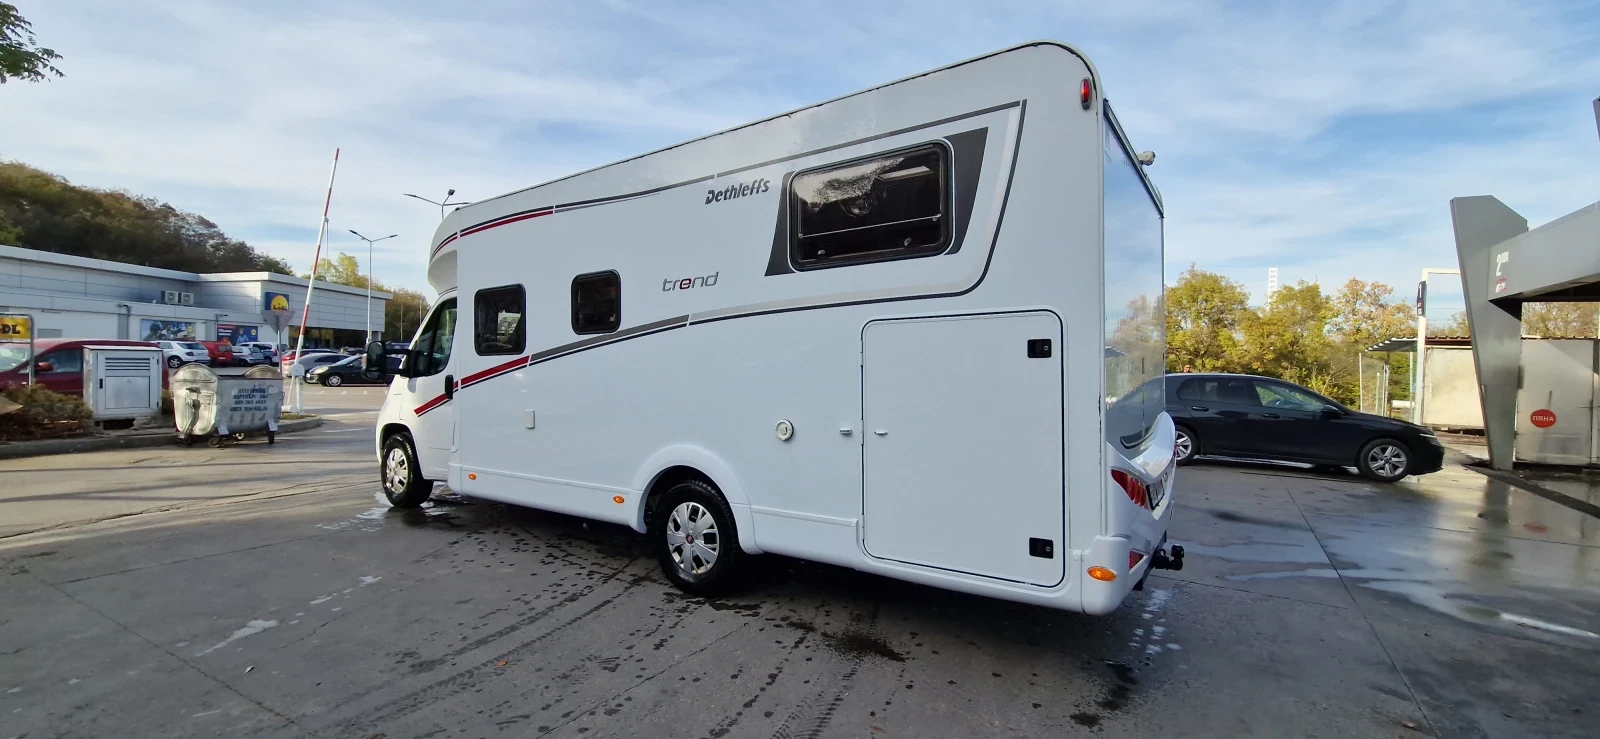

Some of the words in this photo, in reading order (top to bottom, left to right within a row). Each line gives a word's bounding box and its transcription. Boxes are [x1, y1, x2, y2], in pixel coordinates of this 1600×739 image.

[705, 178, 770, 205] Dethleffs
[662, 271, 719, 292] trend
[0, 323, 21, 335] DL
